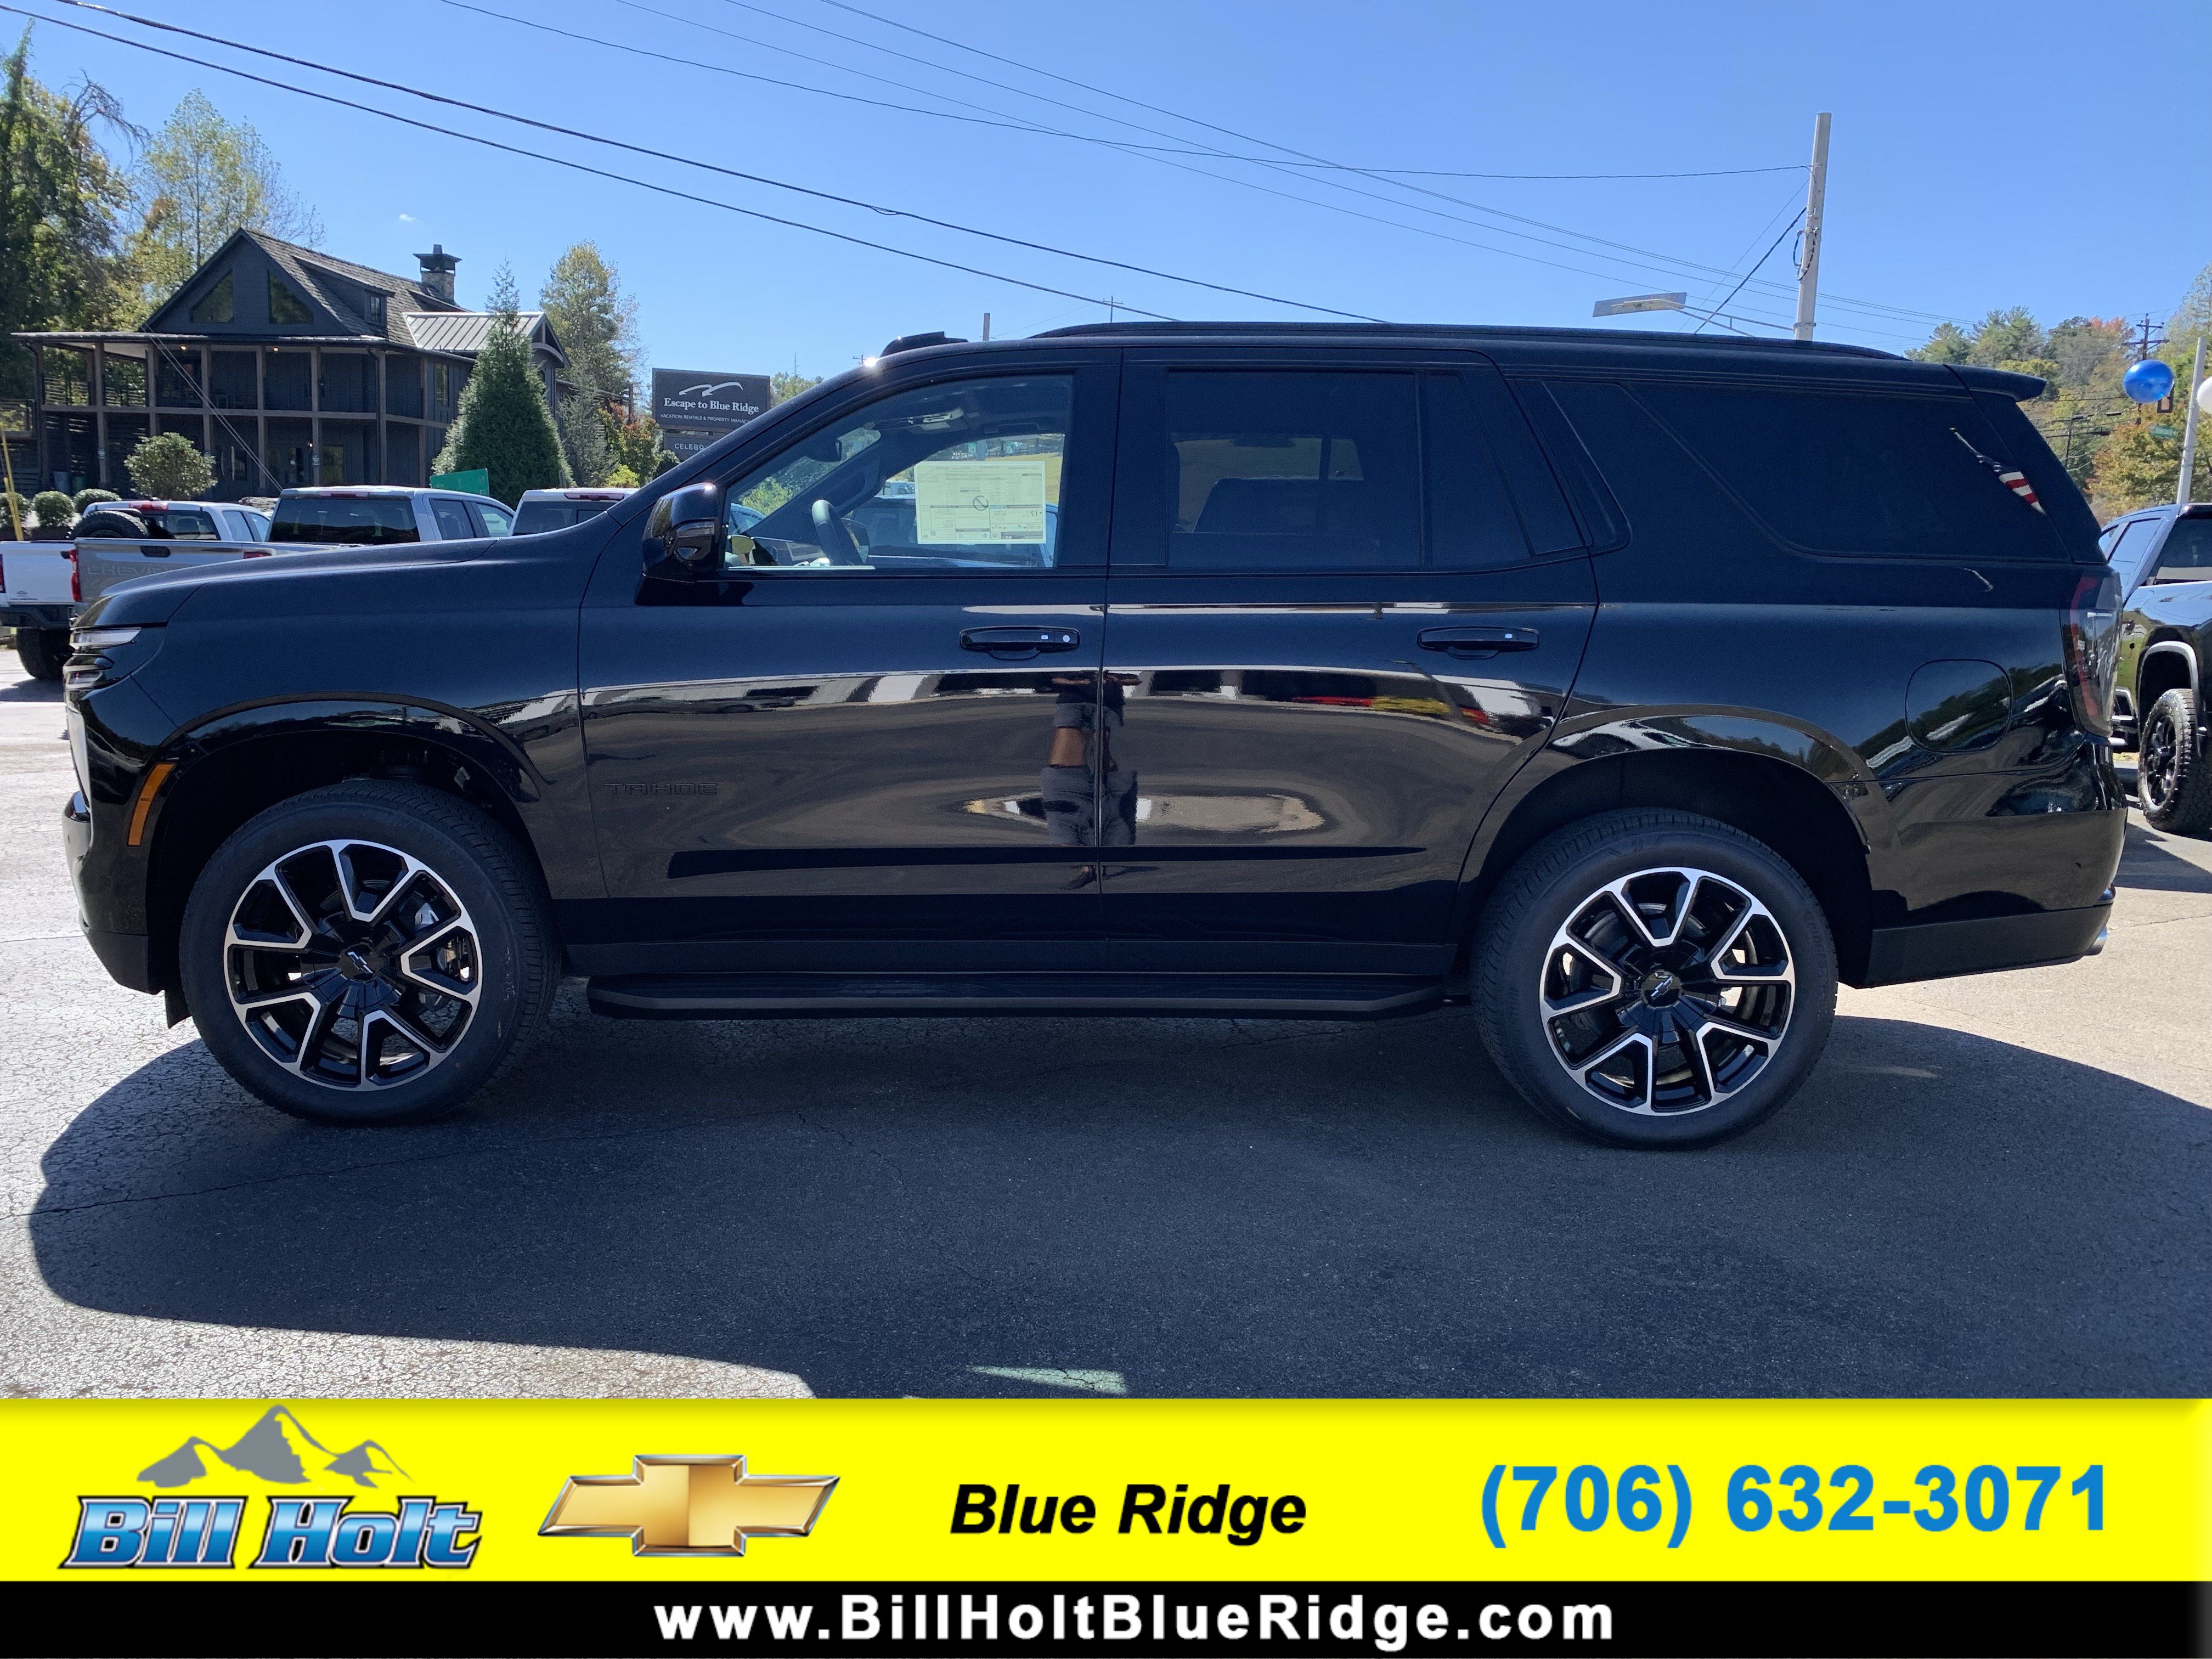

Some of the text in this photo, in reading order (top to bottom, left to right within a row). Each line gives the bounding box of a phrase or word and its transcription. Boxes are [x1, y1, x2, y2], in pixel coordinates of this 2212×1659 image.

[664, 398, 696, 410] Escape
[709, 400, 730, 410] Blue
[732, 402, 759, 415] Ridge
[674, 443, 708, 452] CELEBR
[604, 783, 718, 795] TAHOE
